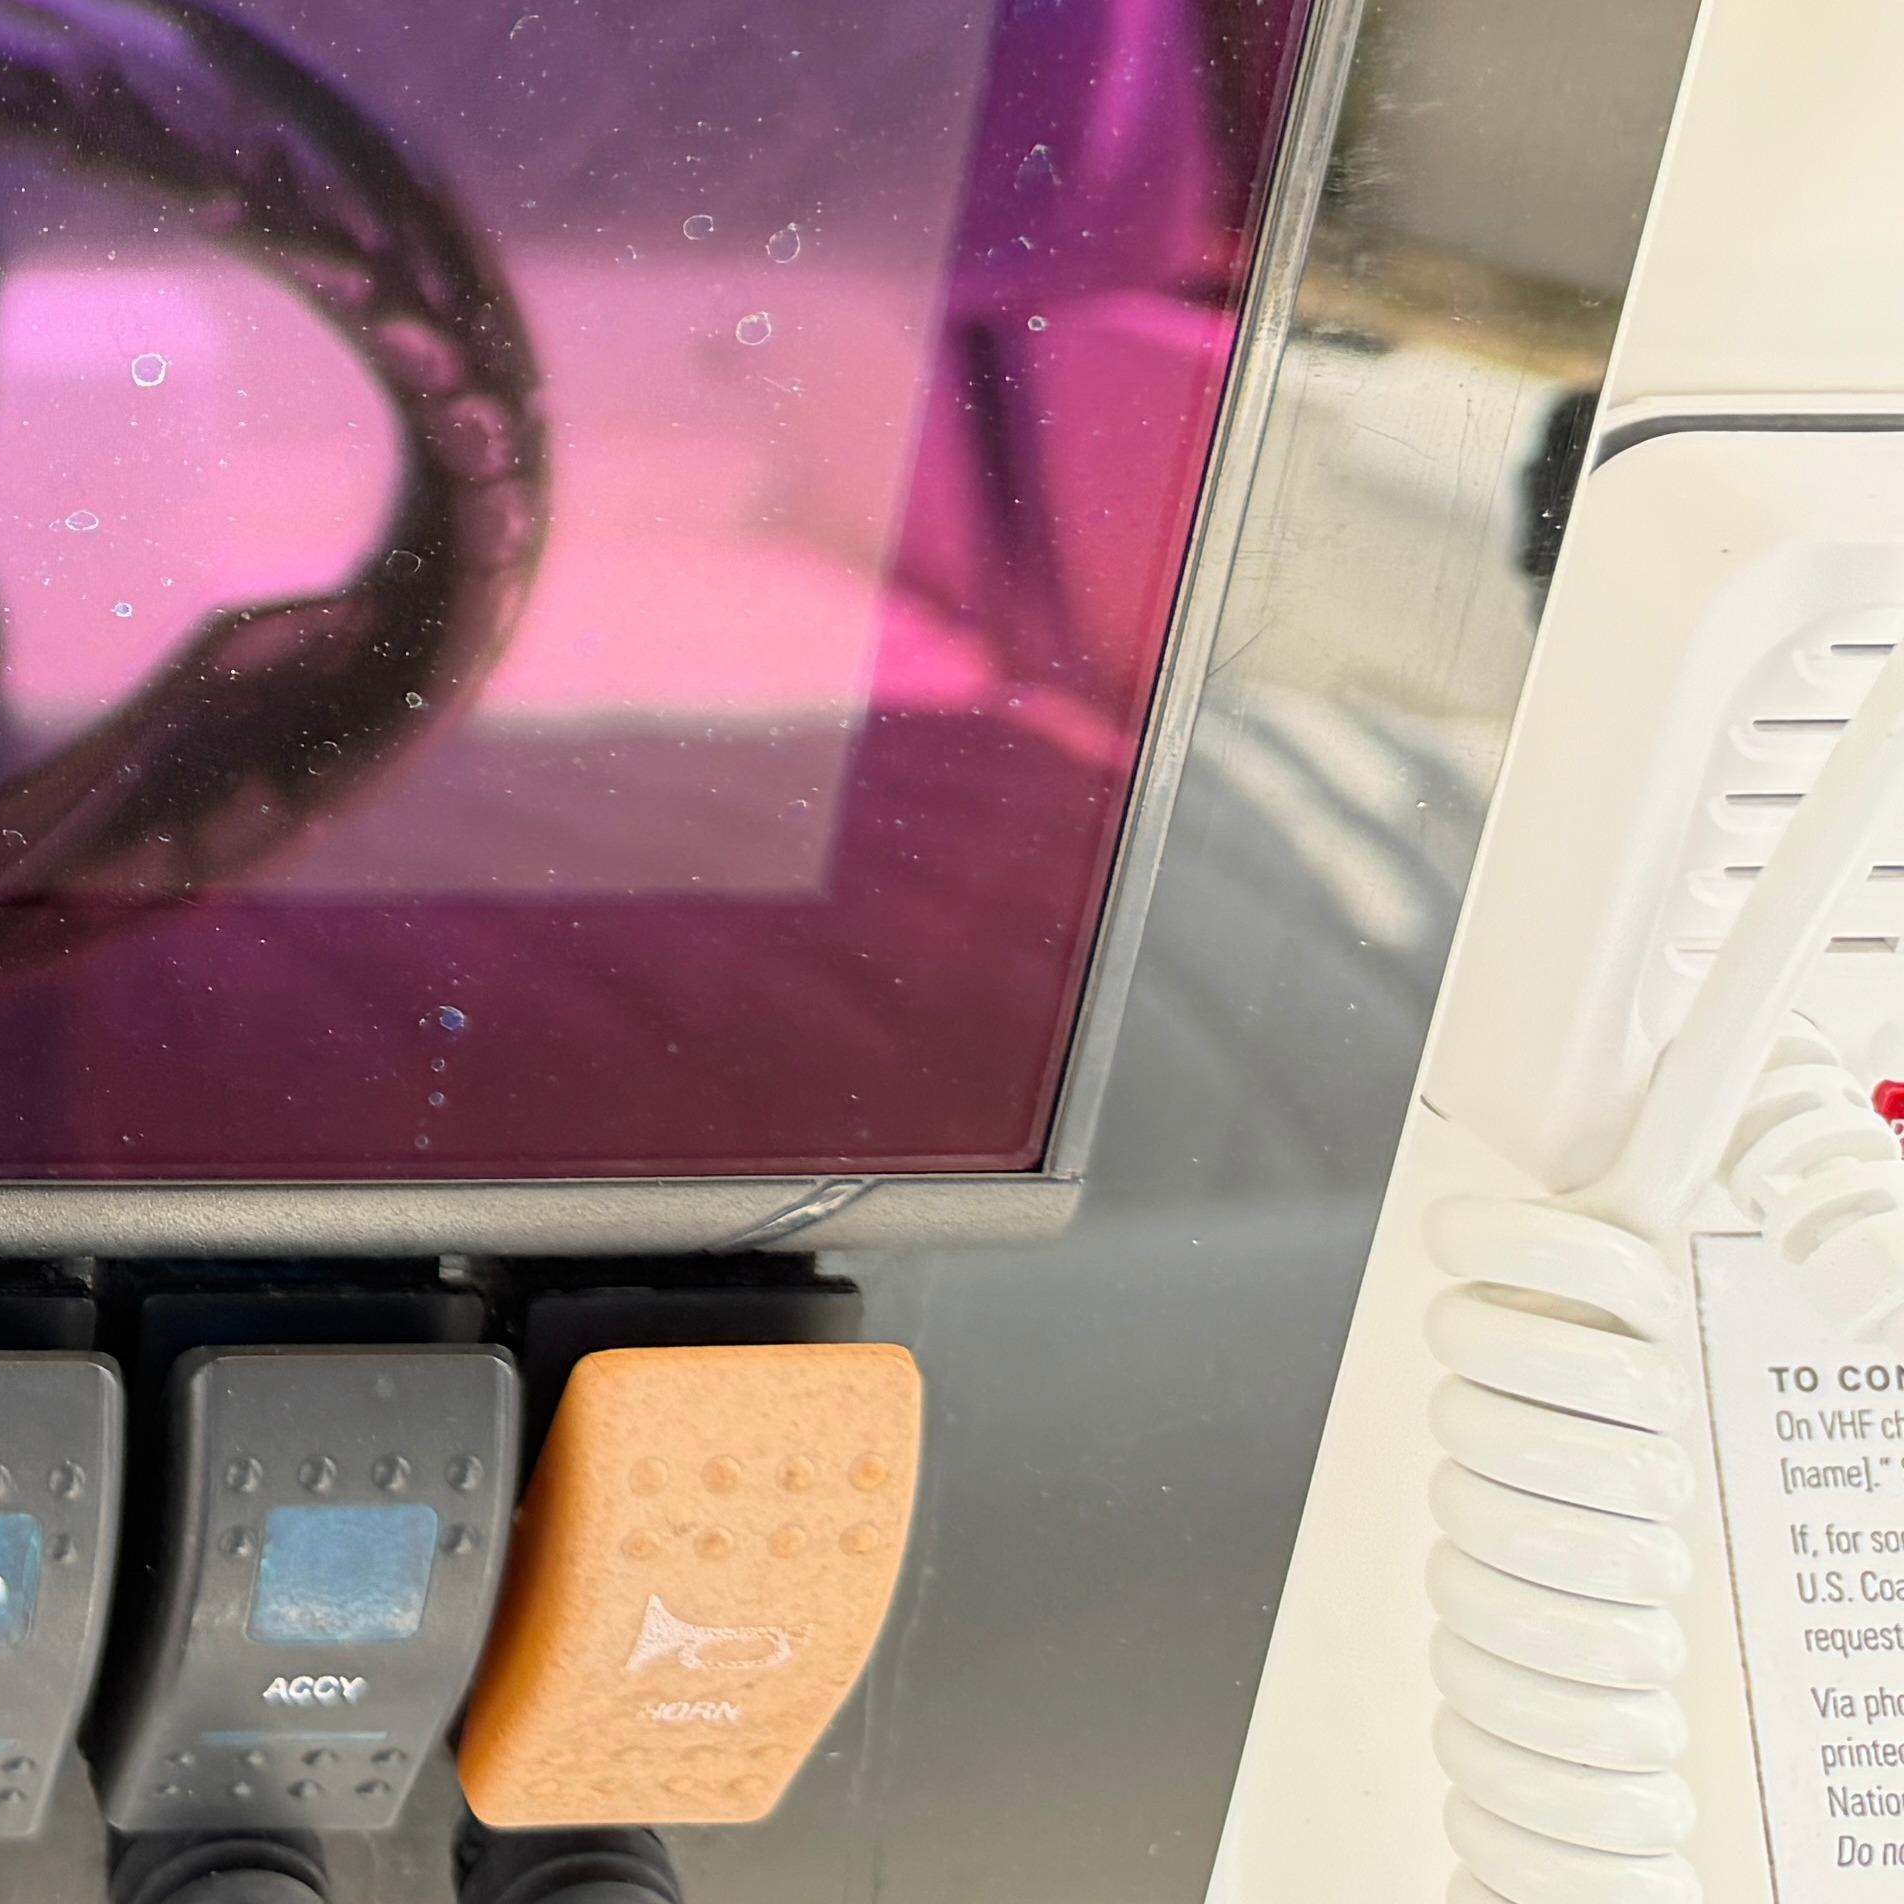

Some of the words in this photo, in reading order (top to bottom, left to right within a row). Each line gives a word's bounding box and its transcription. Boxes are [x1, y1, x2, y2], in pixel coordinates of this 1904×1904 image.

[1768, 1366, 1819, 1393] TO
[1775, 1409, 1812, 1441] On
[1817, 1408, 1874, 1440] VHF
[1790, 1523, 1818, 1557] If,
[1825, 1523, 1863, 1554] for
[1870, 1530, 1904, 1554] so
[1796, 1571, 1854, 1603] U.S.
[1804, 1623, 1904, 1658] request
[262, 1675, 367, 1704] ACCY
[1810, 1687, 1856, 1718] Via
[1827, 1785, 1904, 1817] Natio
[1837, 1835, 1873, 1867] Do
